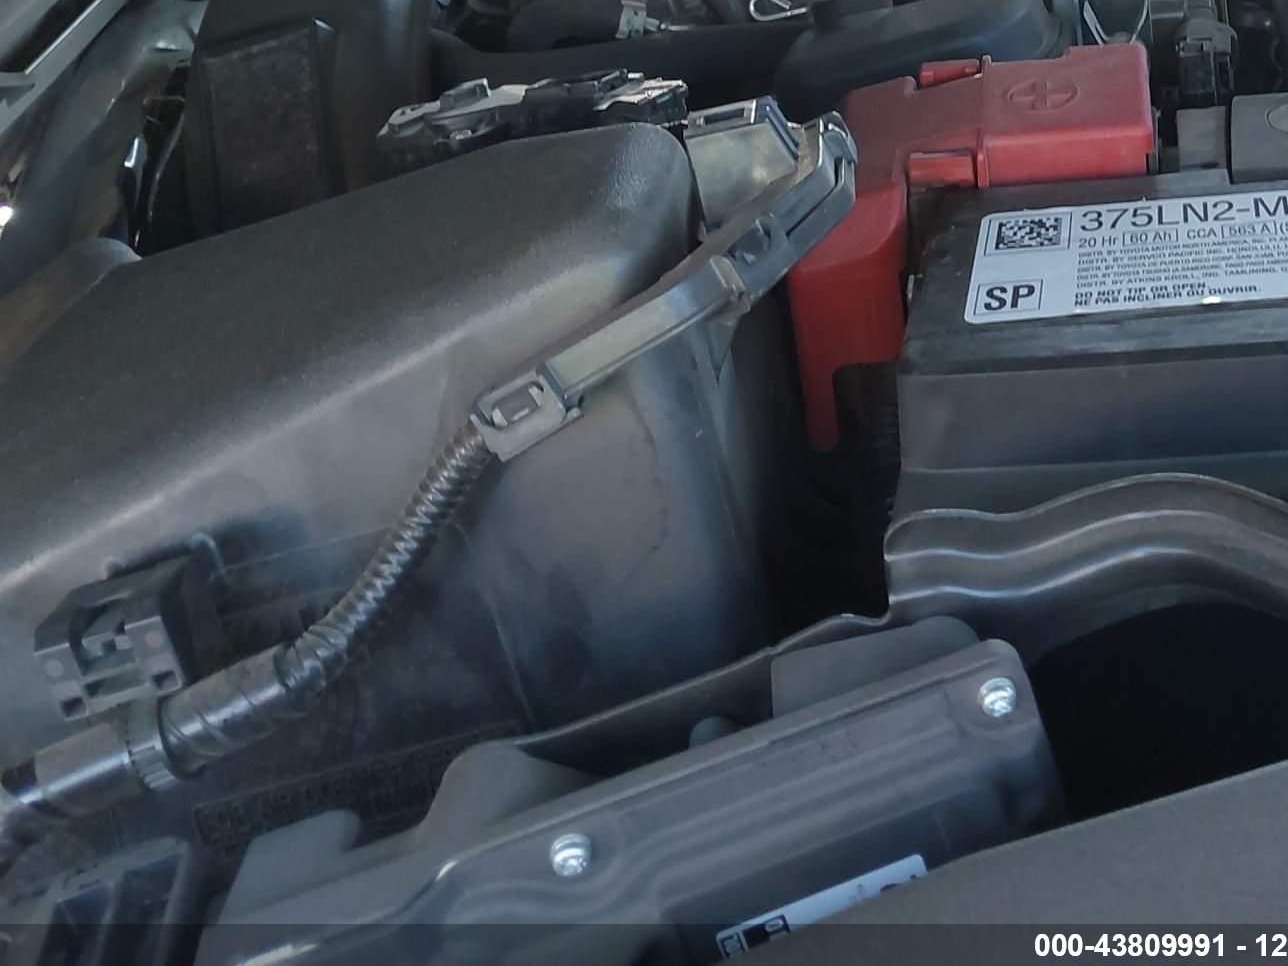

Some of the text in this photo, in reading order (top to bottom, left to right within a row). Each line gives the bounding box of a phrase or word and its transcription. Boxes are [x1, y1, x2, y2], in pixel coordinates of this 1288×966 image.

[1078, 236, 1097, 248] 20
[1101, 234, 1117, 246] Hr
[1129, 232, 1147, 243] 60
[1153, 230, 1170, 241] Ah
[1186, 226, 1216, 239] CCA
[1259, 223, 1270, 234] A
[984, 284, 1035, 310] SP
